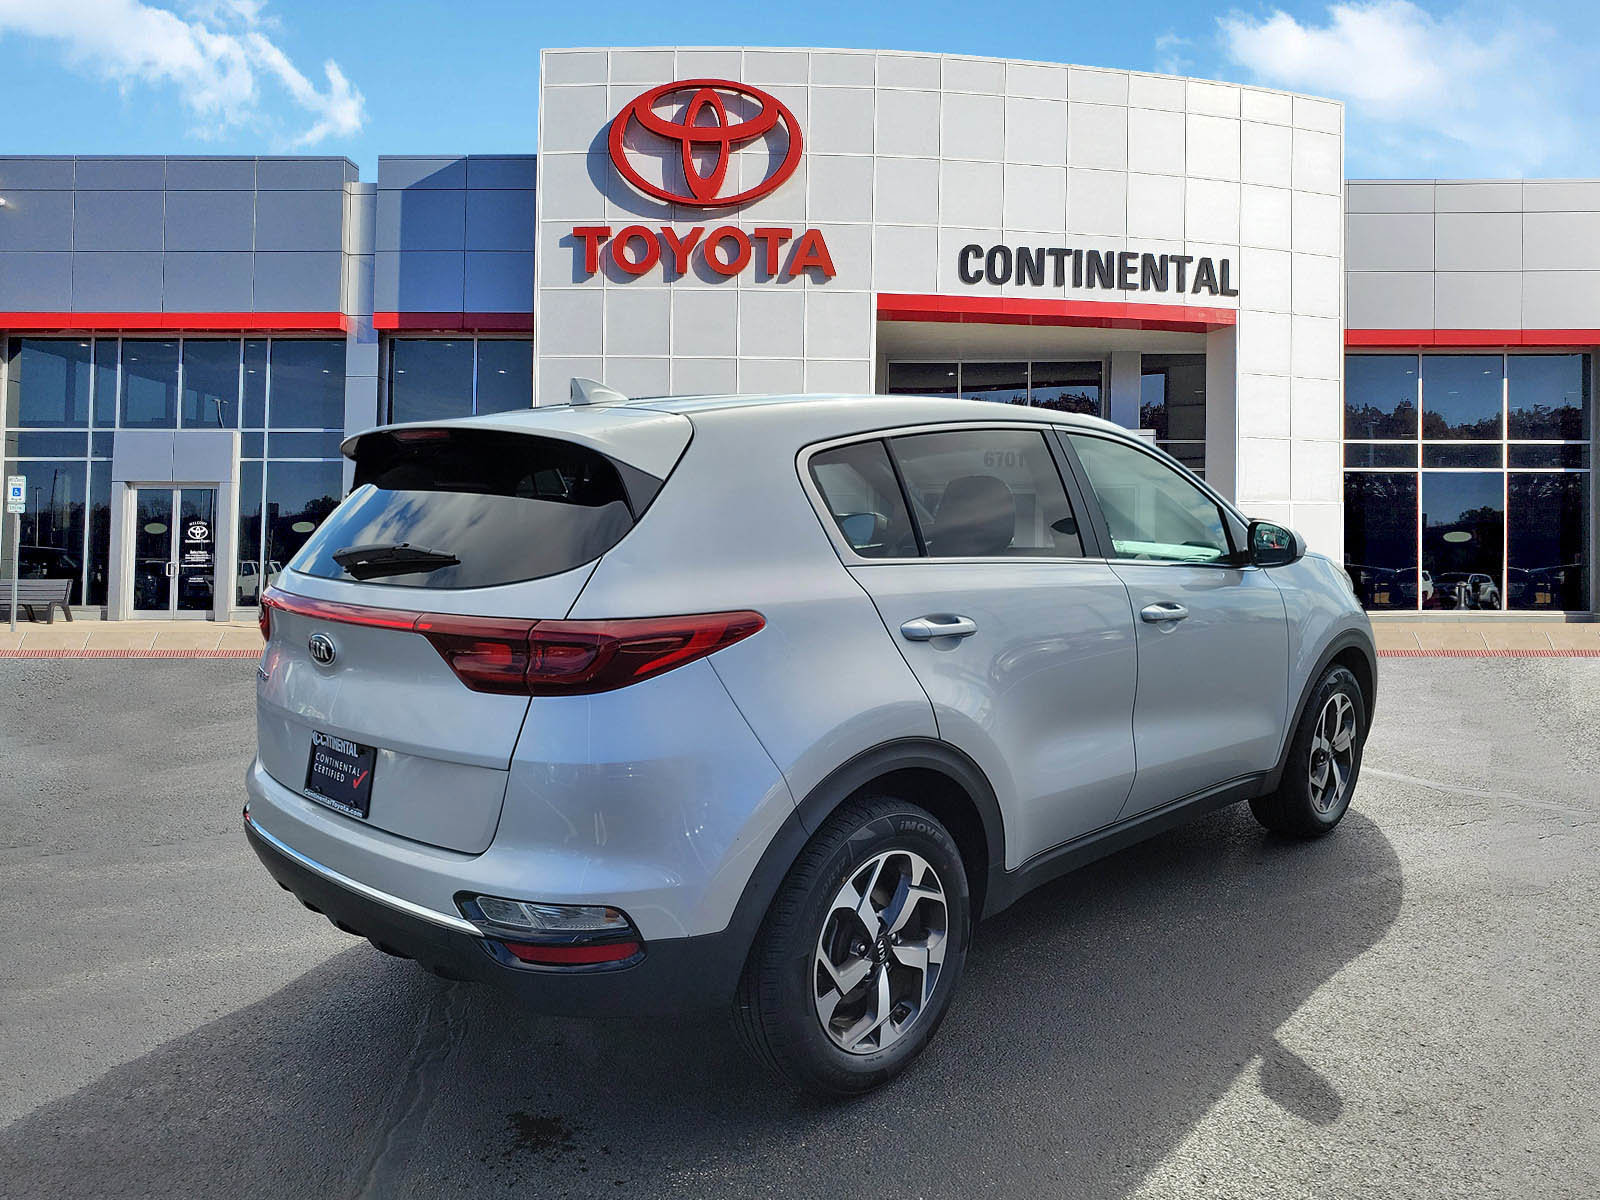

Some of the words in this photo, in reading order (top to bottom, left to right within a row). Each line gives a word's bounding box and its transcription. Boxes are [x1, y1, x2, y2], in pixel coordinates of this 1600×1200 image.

[572, 225, 837, 277] TOYOTA
[958, 243, 1239, 296] CONTINENTAL
[311, 640, 329, 660] KIA
[313, 763, 345, 783] CERTIFIED
[315, 752, 361, 777] CONTINENTAL
[900, 820, 944, 841] iMOVE
[877, 940, 886, 961] KIA
